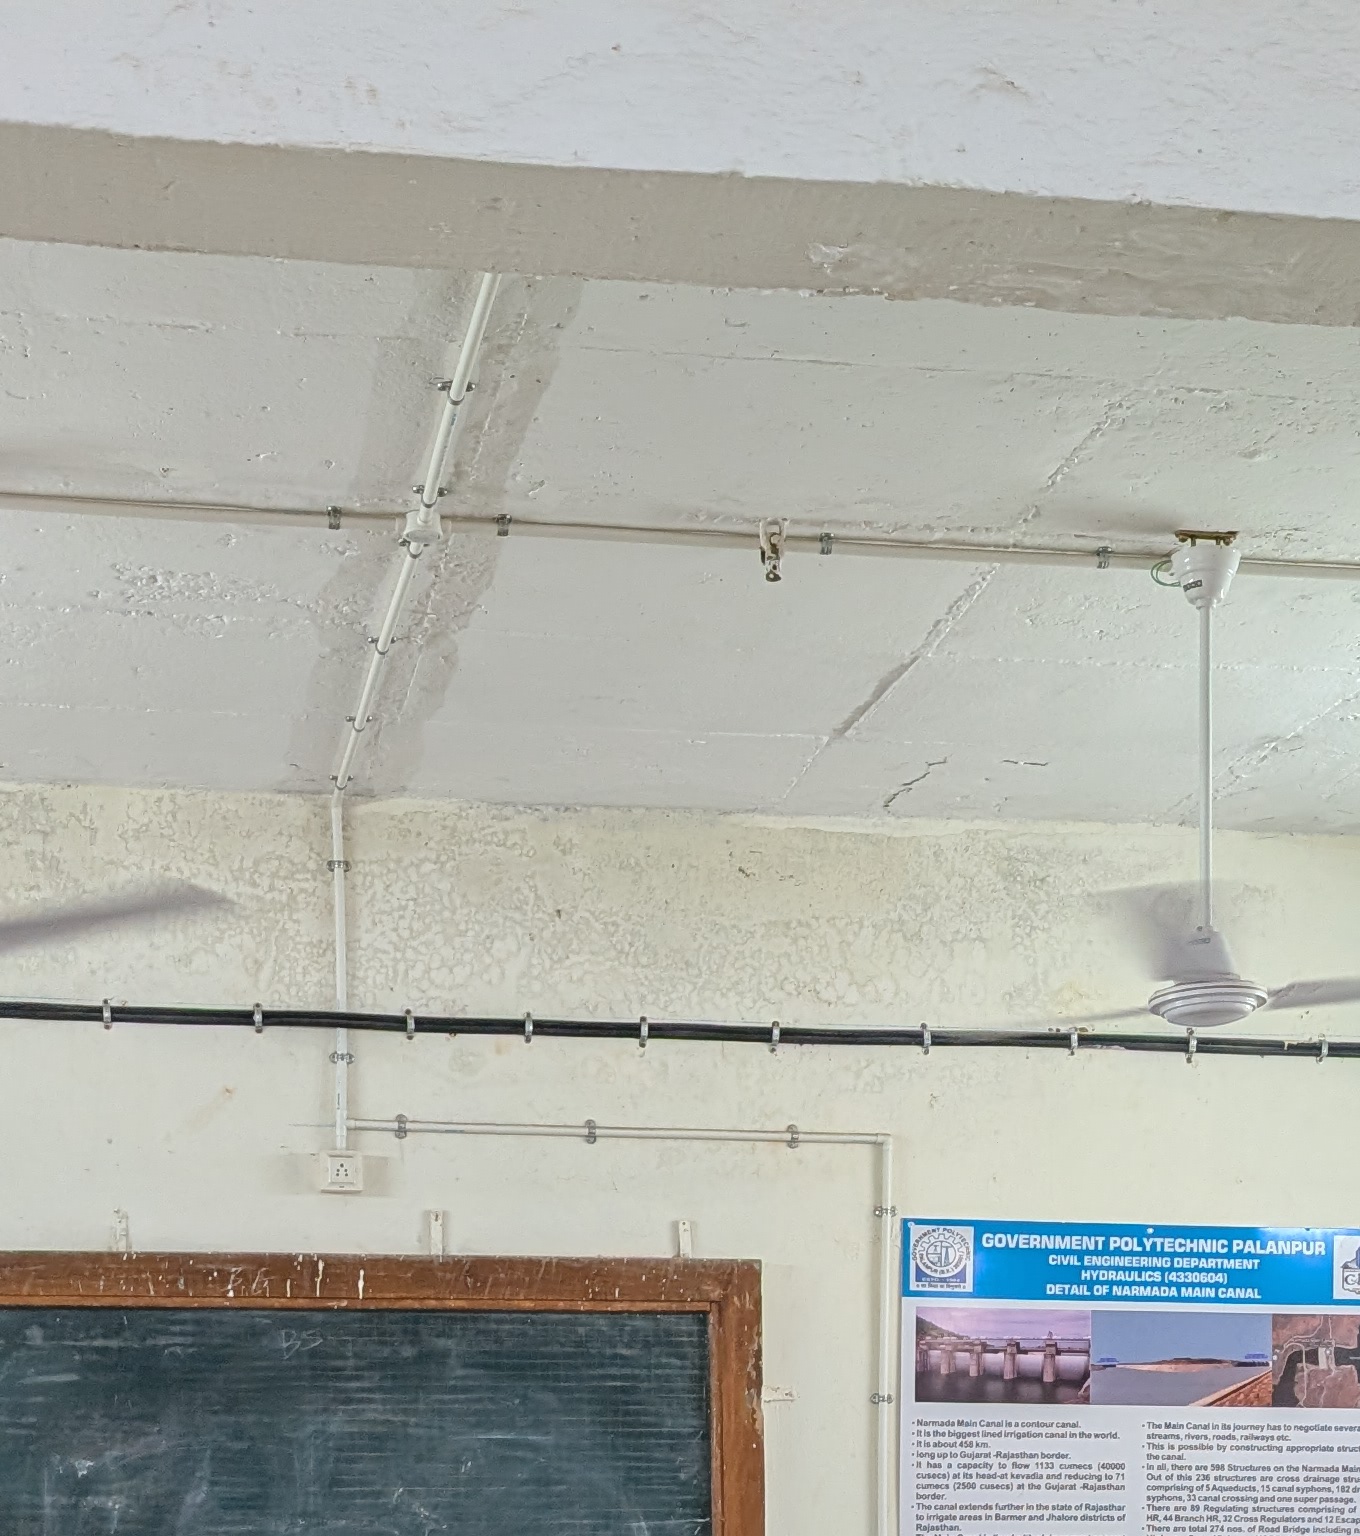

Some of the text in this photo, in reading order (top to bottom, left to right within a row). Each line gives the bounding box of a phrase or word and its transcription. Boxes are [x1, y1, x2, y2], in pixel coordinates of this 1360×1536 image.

[981, 1233, 1326, 1255] GOVERNMENT POLYTECHNIC PALANPUR
[1048, 1254, 1260, 1269] CIVIL ENGINEERING DEPARTMENT
[1080, 1269, 1228, 1283] HYDRAULICS (4330604)
[1045, 1283, 1262, 1299] DETAIL OF NARMADA MAIN CANAL
[916, 1418, 955, 1427] Narmada
[956, 1418, 977, 1427] Main
[978, 1419, 1003, 1427] Canal
[1004, 1419, 1012, 1427] is
[1020, 1419, 1054, 1428] contour
[1055, 1419, 1081, 1428] canal.
[1146, 1420, 1162, 1429] The
[1163, 1421, 1184, 1429] Main
[1185, 1421, 1210, 1430] Canal
[1211, 1421, 1219, 1430] in
[1220, 1422, 1231, 1430] its
[1232, 1422, 1265, 1432] journey
[1266, 1422, 1282, 1431] has
[1283, 1422, 1292, 1431] to
[1293, 1423, 1332, 1433] negotiate
[916, 1429, 1120, 1440] It is the biggest lined irrigation canal in the world.
[1146, 1431, 1291, 1443] streams, rivers, roads, railways etc.
[916, 1439, 991, 1448] It is about 458 km.
[916, 1450, 935, 1460] long
[936, 1451, 948, 1460] up
[949, 1450, 958, 1459] to
[959, 1450, 991, 1461] Gujarat
[1040, 1450, 1071, 1459] border.
[1146, 1462, 1154, 1470] In
[1170, 1462, 1193, 1471] there
[1210, 1462, 1225, 1471] 598
[1227, 1463, 1271, 1472] Structures
[1285, 1463, 1299, 1472] the
[1301, 1464, 1339, 1473] Narmada
[1341, 1464, 1360, 1473] Main
[1146, 1472, 1162, 1481] Out
[1164, 1472, 1174, 1481] of
[1176, 1472, 1192, 1481] this
[1195, 1472, 1210, 1481] 236
[1213, 1473, 1257, 1482] structures
[1302, 1474, 1340, 1485] drainage
[915, 1482, 949, 1490] cumecs
[952, 1481, 976, 1492] (2500
[979, 1481, 1013, 1492] cusecs)
[1016, 1481, 1025, 1490] at
[1027, 1481, 1041, 1490] the
[1044, 1482, 1076, 1492] Gujarat
[915, 1491, 947, 1500] border.
[1162, 1513, 1173, 1522] 44
[1174, 1513, 1204, 1522] Branch
[1222, 1514, 1232, 1522] 32
[1233, 1514, 1258, 1523] Cross
[1259, 1514, 1306, 1525] Regulators
[1306, 1515, 1323, 1523] and
[1324, 1515, 1334, 1523] 12
[915, 1523, 961, 1533] Rajasthan.
